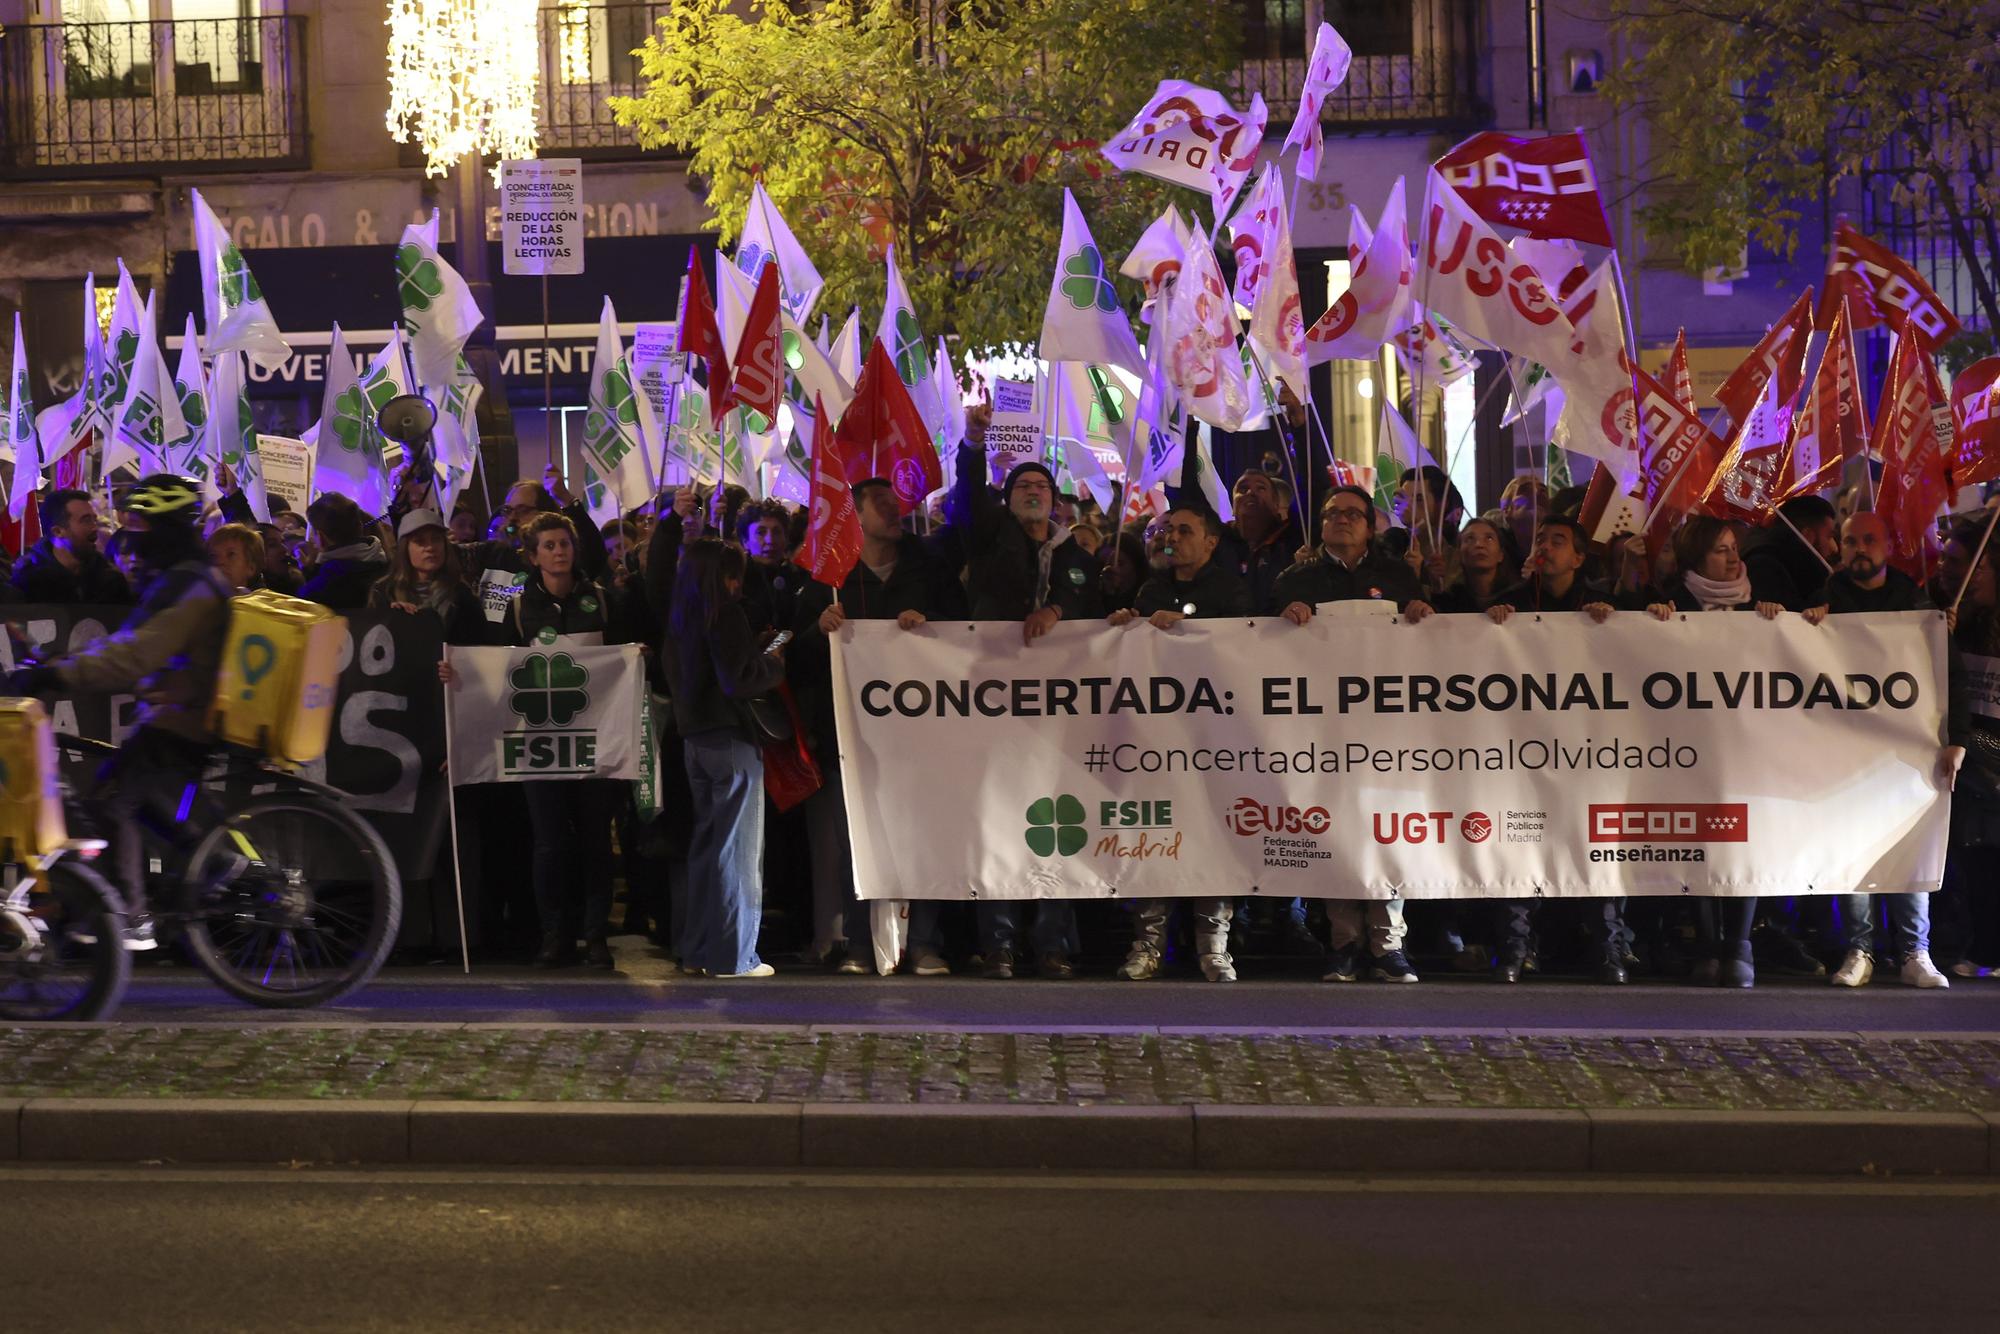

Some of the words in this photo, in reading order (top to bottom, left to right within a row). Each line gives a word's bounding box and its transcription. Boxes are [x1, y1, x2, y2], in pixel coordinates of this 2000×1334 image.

[1308, 182, 1345, 211] 35
[506, 210, 577, 221] REDUCCIÓN
[521, 225, 537, 233] DE
[540, 225, 563, 233] LAS
[521, 237, 564, 245] HORAS
[515, 249, 571, 257] LECTIVAS
[583, 411, 632, 471] SIE
[985, 443, 1033, 453] LVIDADO
[861, 677, 1234, 717] CONCERTADA:
[1262, 677, 1323, 715] EL
[1338, 672, 1629, 714] PERSONAL
[1642, 671, 1919, 711] OLVIDADO
[503, 736, 597, 768] FSIE
[1084, 737, 1698, 774] #ConcertadaPersonalOlvidado
[1100, 800, 1172, 826] FSIE
[1507, 810, 1547, 819] Servicios
[1373, 812, 1453, 844] UGT
[1507, 822, 1544, 830] Públicos
[1597, 812, 1697, 835] CCOO
[1264, 836, 1317, 849] Federación
[1507, 833, 1542, 842] Madrid
[1093, 831, 1183, 862] Madrid
[1264, 848, 1276, 856] de
[1279, 848, 1332, 860] Enseñanza
[1589, 845, 1705, 862] enseñanza
[1264, 858, 1309, 868] MADRID
